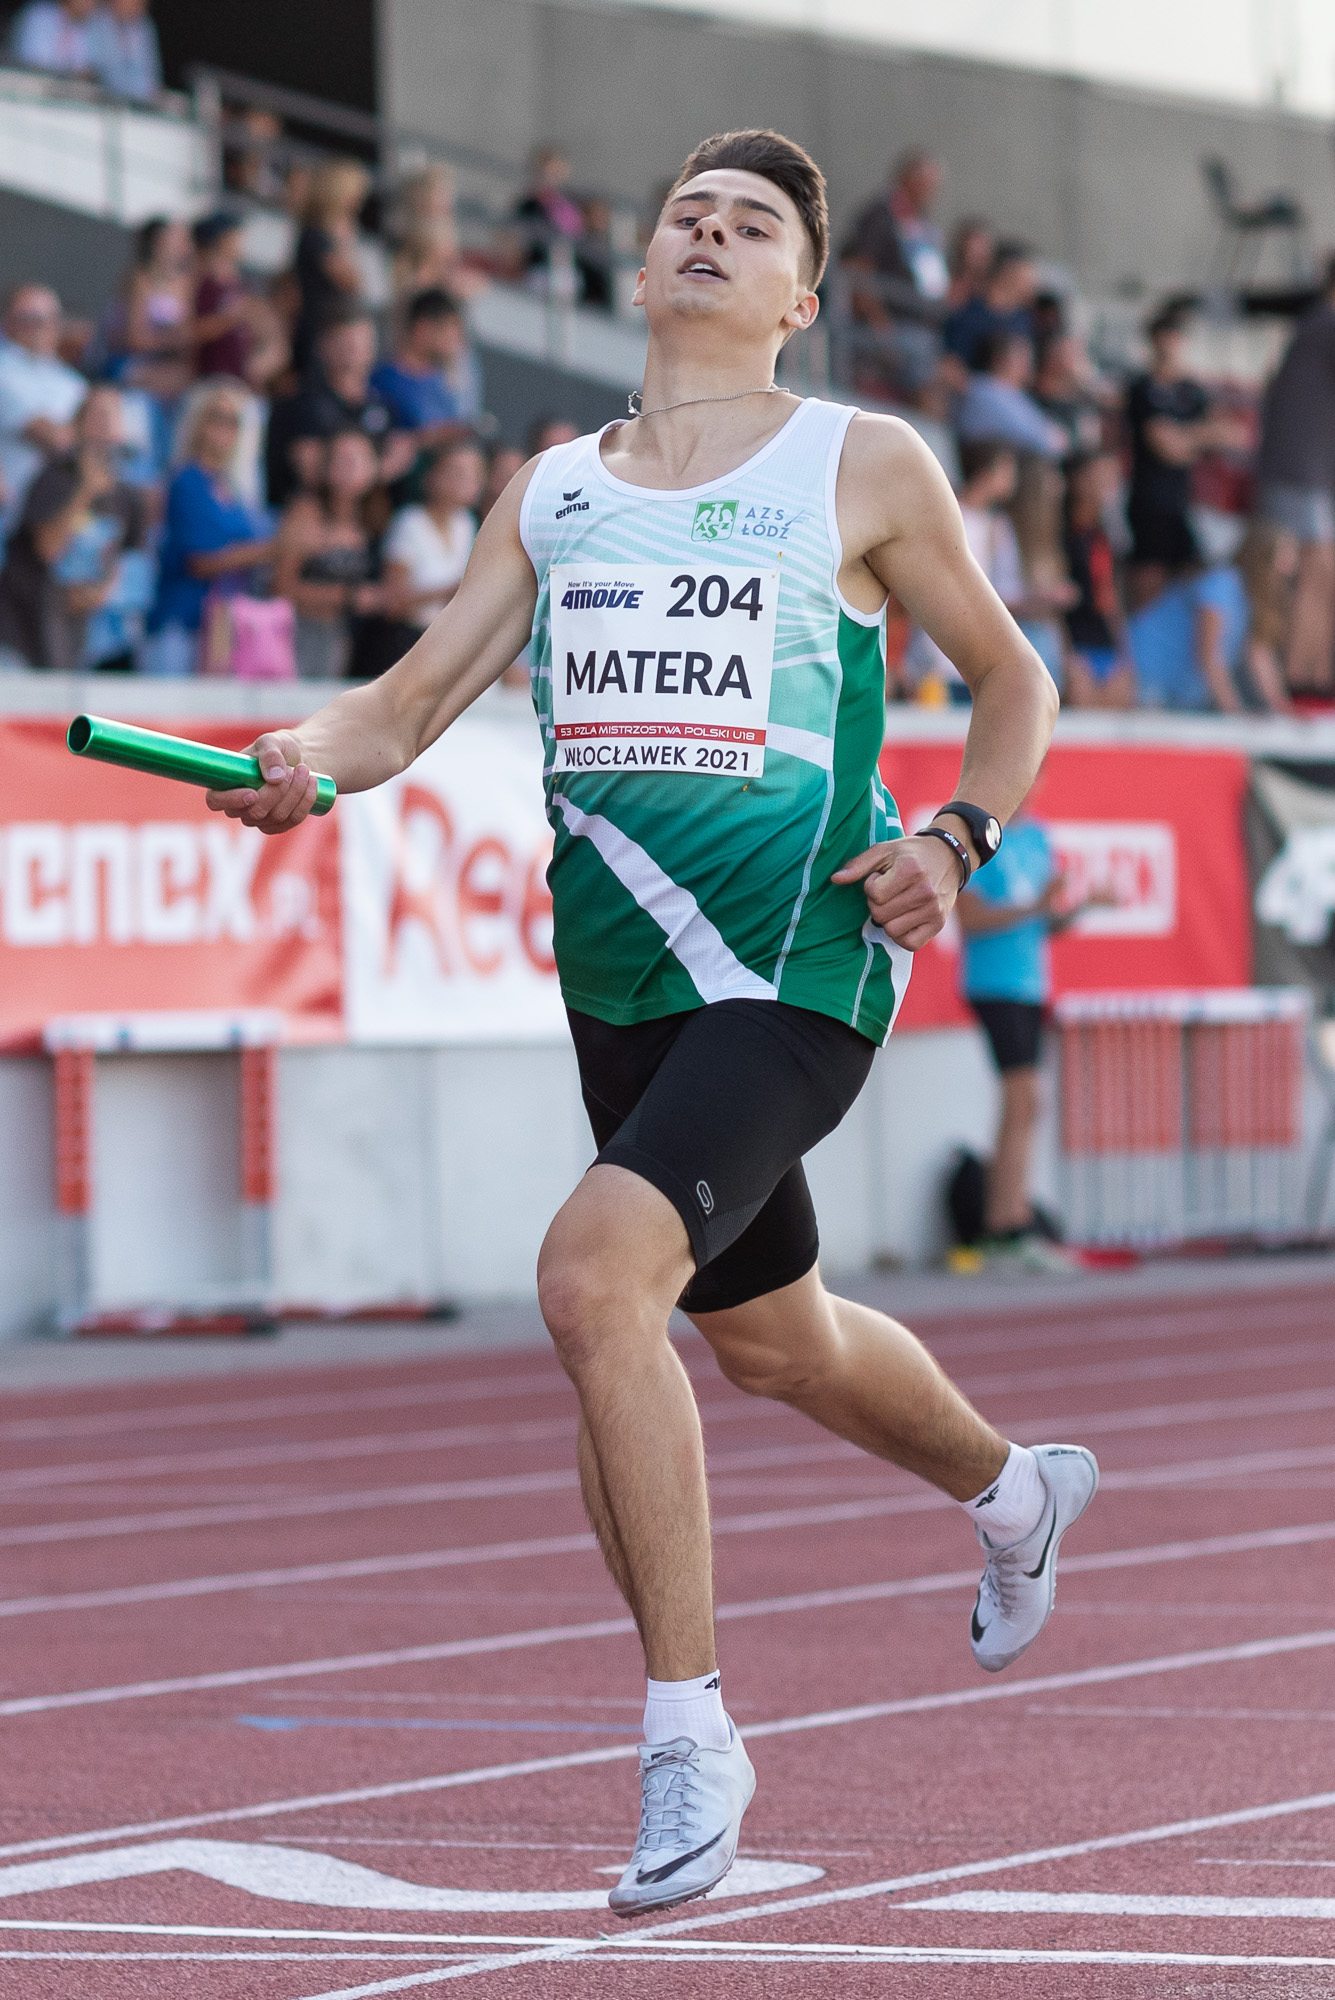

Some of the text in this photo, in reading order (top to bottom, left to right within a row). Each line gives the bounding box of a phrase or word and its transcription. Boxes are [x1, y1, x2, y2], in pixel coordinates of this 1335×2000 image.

[555, 501, 590, 520] erima
[745, 507, 785, 521] AZS
[594, 581, 612, 589] your
[613, 580, 635, 588] Move
[560, 589, 644, 610] 4MOVE
[666, 574, 764, 621] 204
[565, 649, 753, 700] MATERA
[560, 724, 756, 741] 53. PZLA MISTRZOSTWA POLSKI U18
[564, 745, 750, 772] WŁOCŁAWEK 2021
